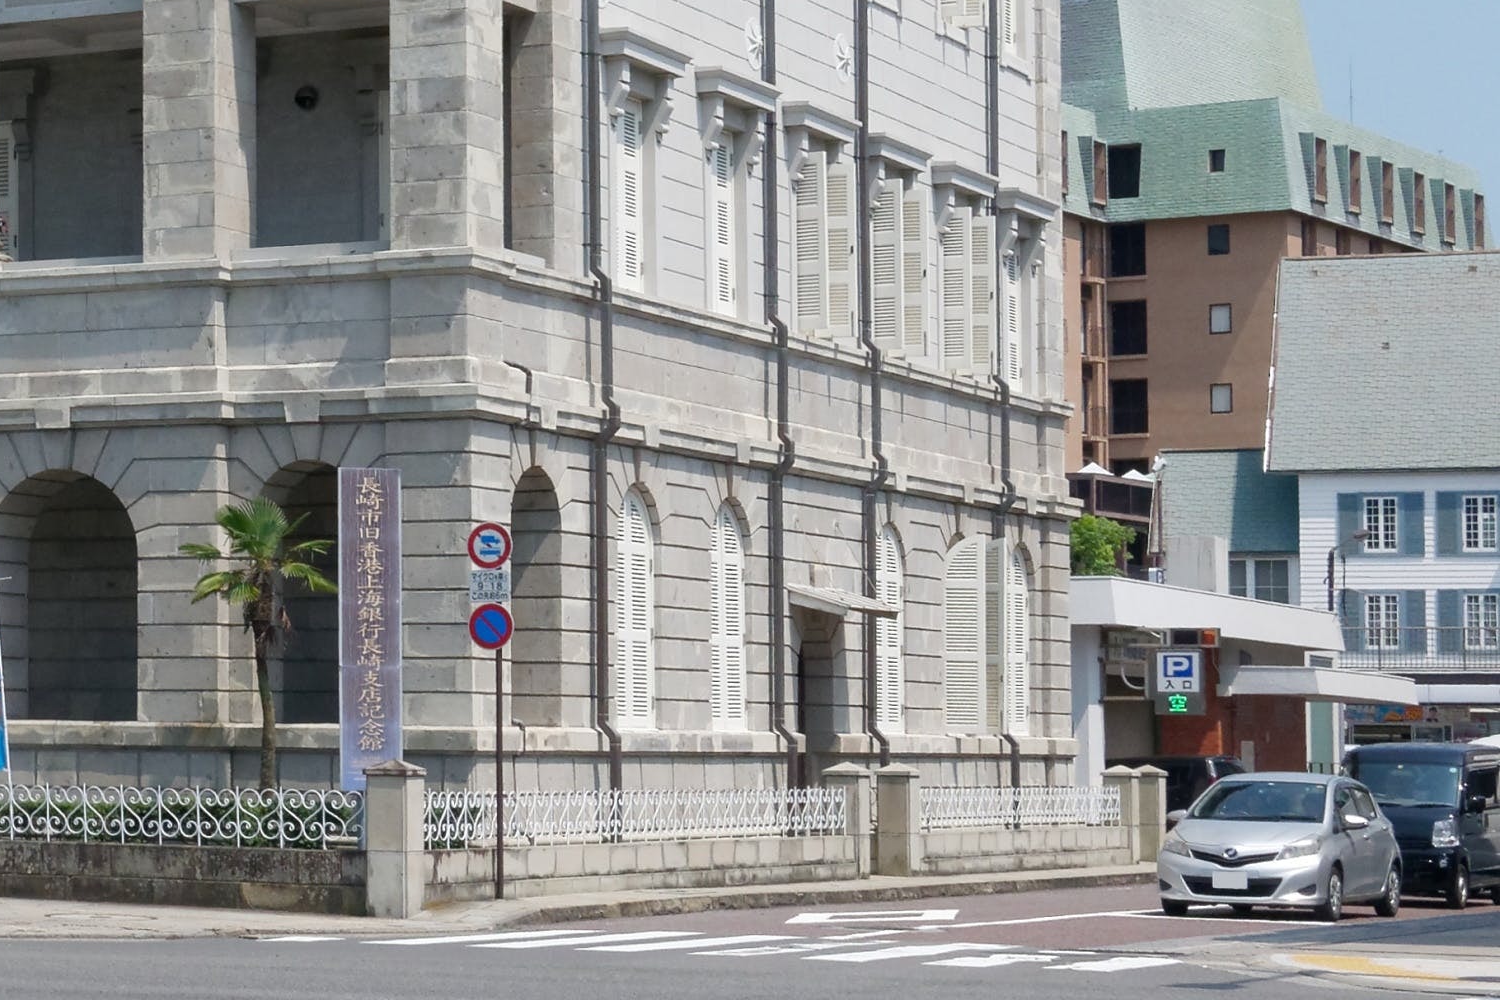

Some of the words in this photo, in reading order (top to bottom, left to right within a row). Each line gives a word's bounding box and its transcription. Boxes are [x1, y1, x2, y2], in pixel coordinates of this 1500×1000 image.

[356, 476, 385, 751] 長崎市旧香港上海銀行長崎支店記念館
[1166, 656, 1190, 676] P
[1164, 680, 1192, 689] 入口
[1168, 693, 1188, 712] 空
